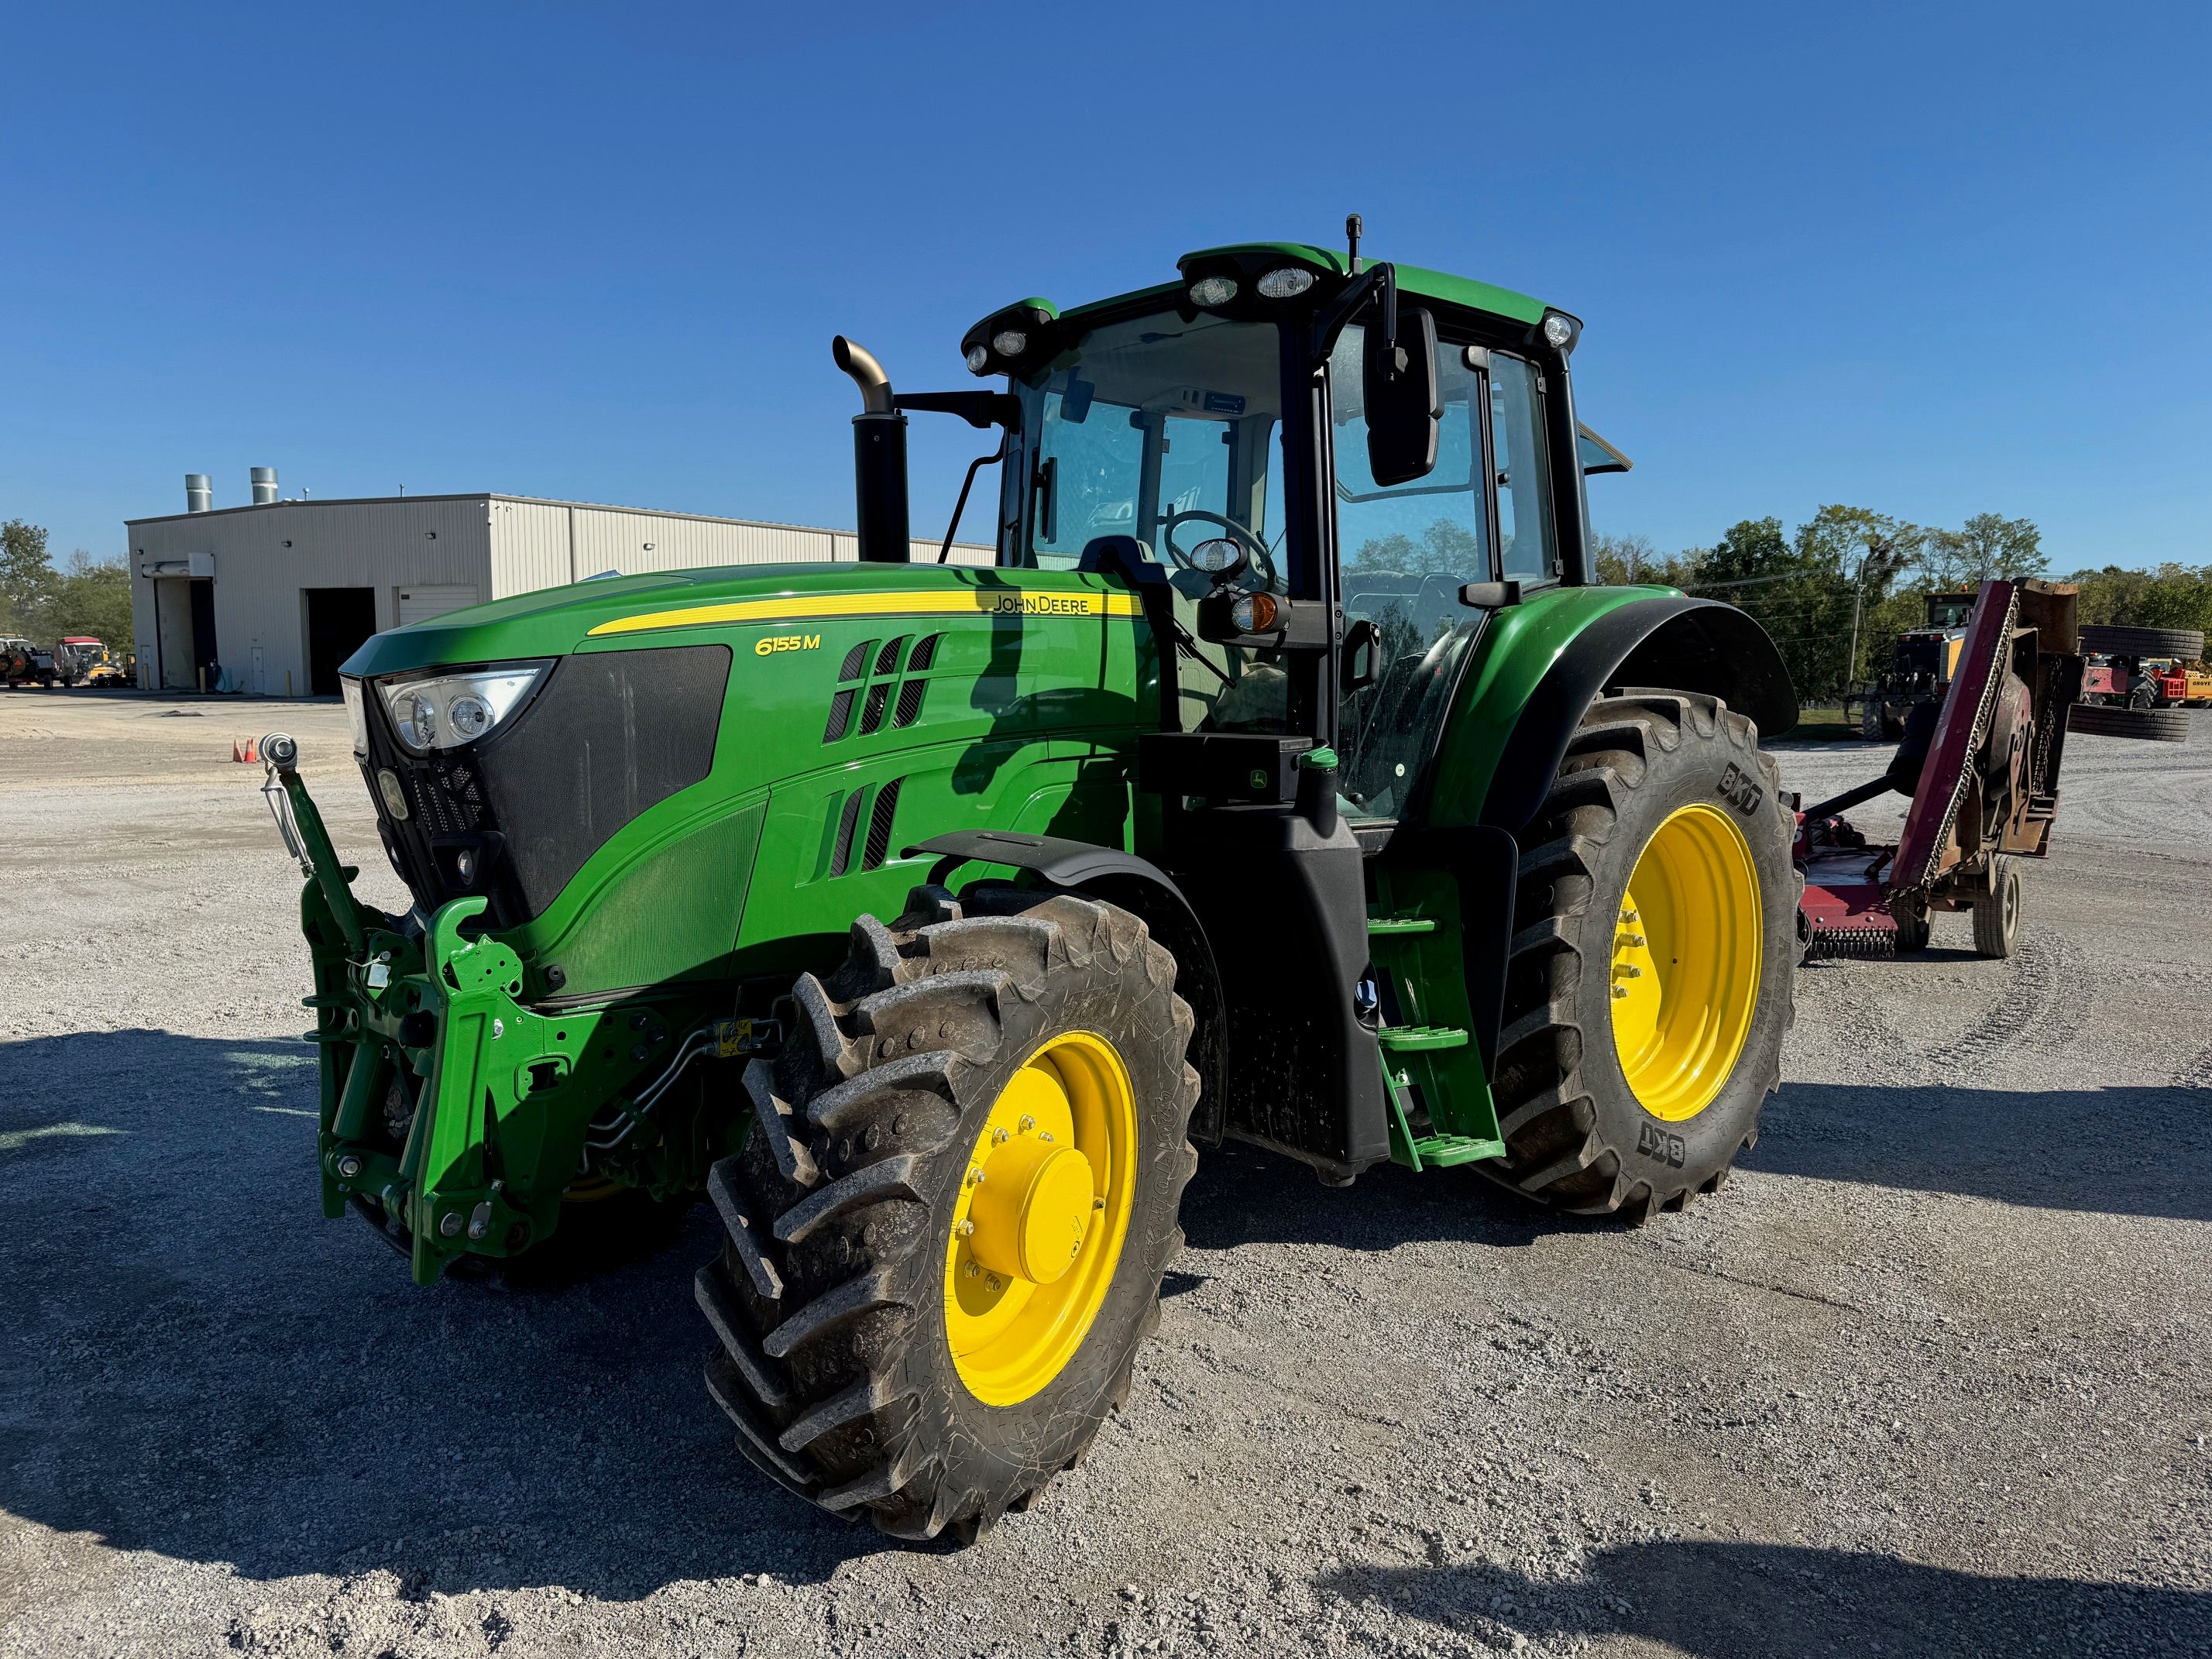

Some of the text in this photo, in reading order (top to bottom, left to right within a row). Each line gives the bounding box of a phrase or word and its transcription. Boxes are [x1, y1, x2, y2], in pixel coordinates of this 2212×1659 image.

[993, 595, 1089, 613] JOHN DEERE
[754, 634, 821, 656] 6155 M
[1719, 765, 1761, 811] BKT
[1640, 1126, 1685, 1163] BKT
